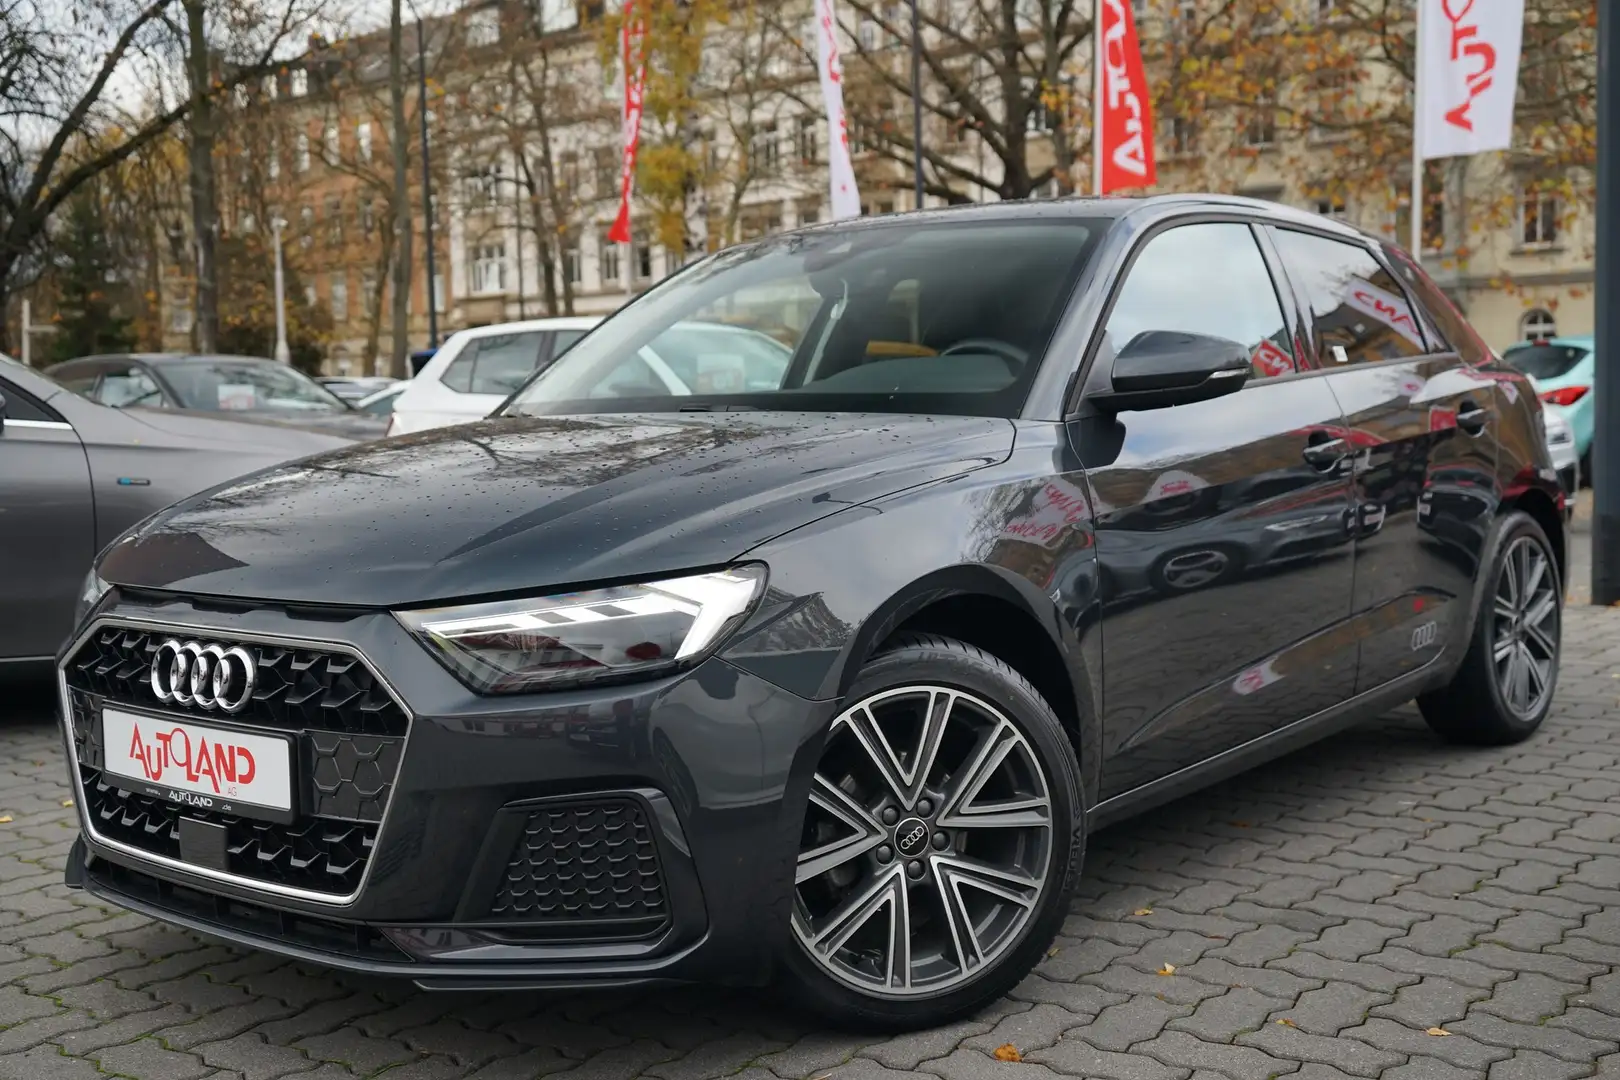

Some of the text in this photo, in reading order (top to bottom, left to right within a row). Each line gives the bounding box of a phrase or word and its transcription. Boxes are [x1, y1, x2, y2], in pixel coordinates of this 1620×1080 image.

[129, 721, 256, 794] AUTOLAND
[168, 790, 213, 808] AUTOLAND
[227, 786, 237, 797] AG
